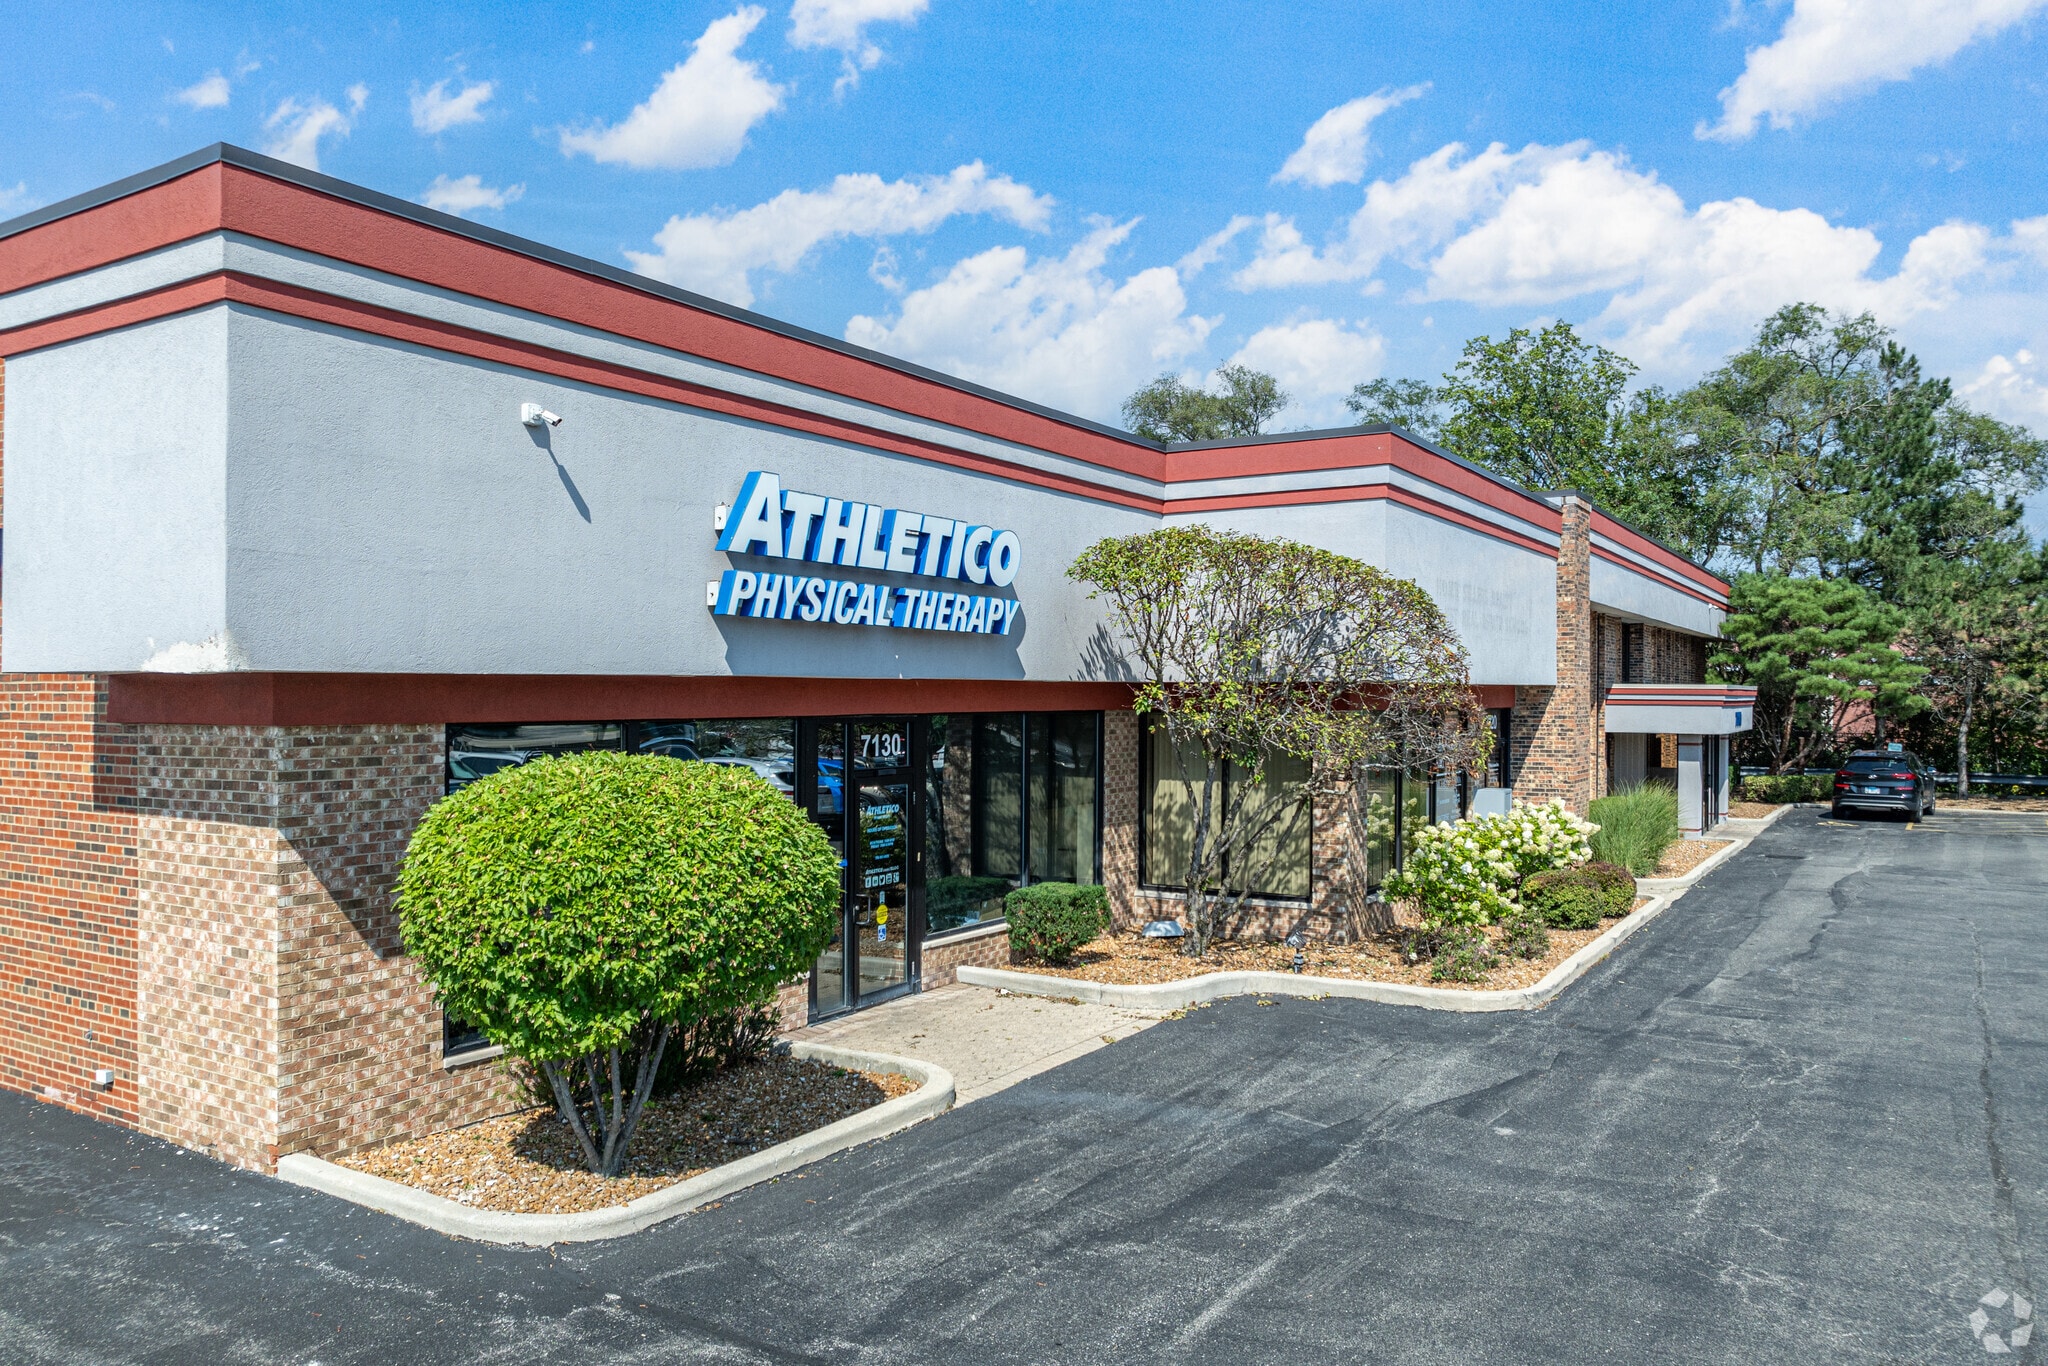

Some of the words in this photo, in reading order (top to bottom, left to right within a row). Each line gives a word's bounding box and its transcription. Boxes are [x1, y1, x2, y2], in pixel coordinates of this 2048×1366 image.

[716, 471, 1021, 587] ATHLETICO
[715, 570, 893, 627] PHYSICAL
[895, 588, 1021, 635] THERAPY
[860, 733, 901, 757] 7130
[866, 804, 900, 816] ATHLETICO
